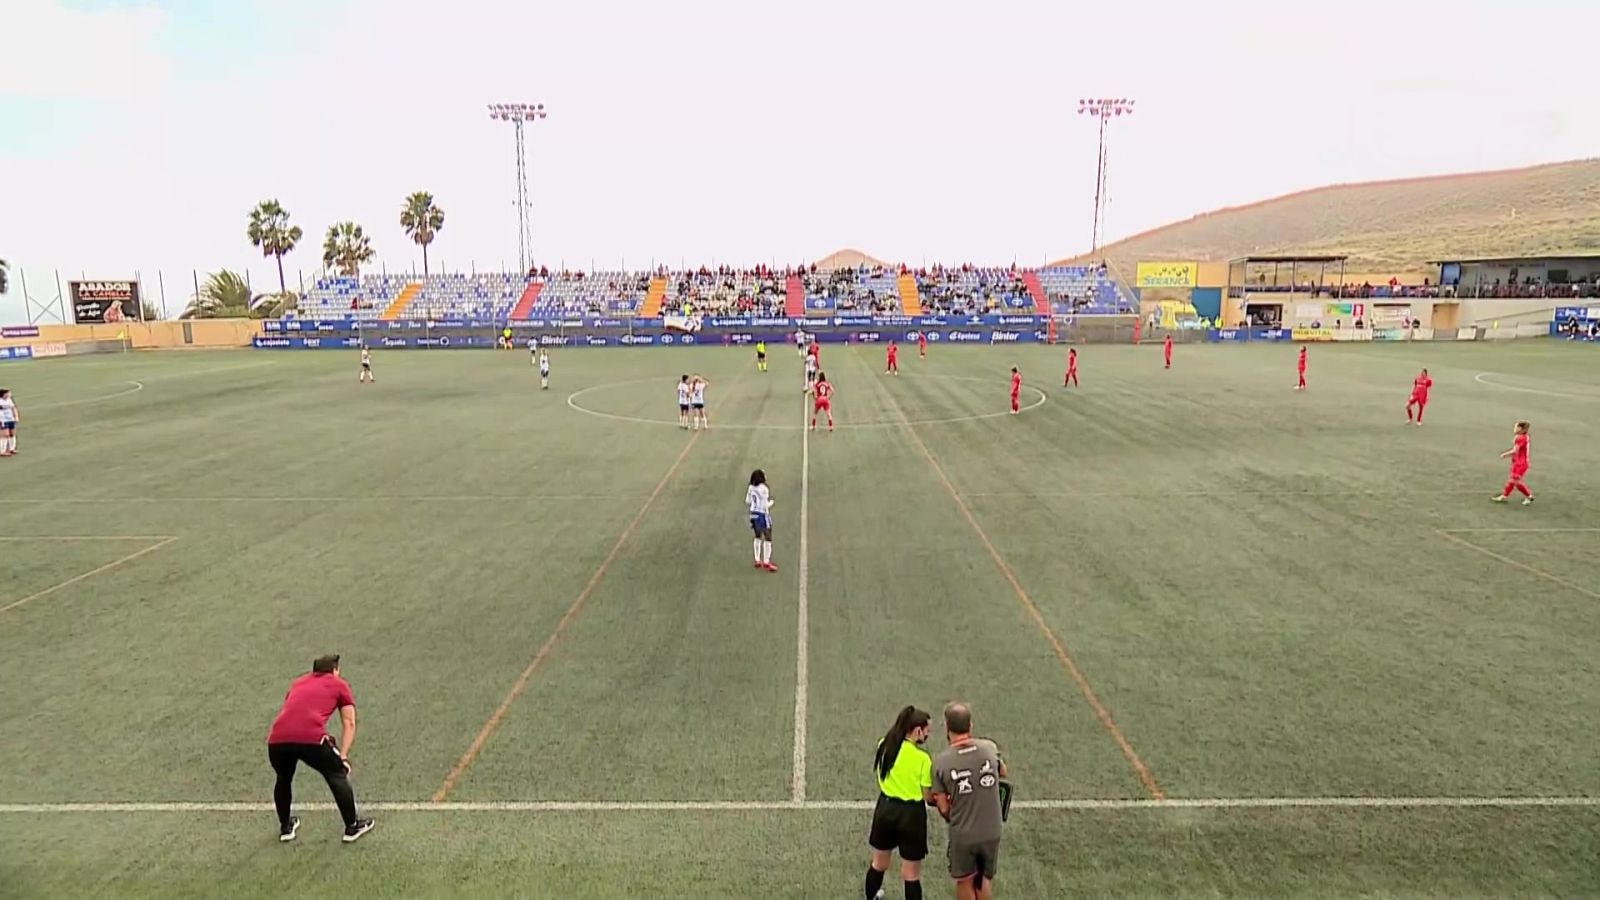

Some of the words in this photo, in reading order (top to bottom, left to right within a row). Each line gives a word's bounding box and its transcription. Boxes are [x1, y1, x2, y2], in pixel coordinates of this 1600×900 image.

[79, 281, 131, 291] ASADOR
[541, 334, 568, 345] Binter
[992, 331, 1020, 341] Binter
